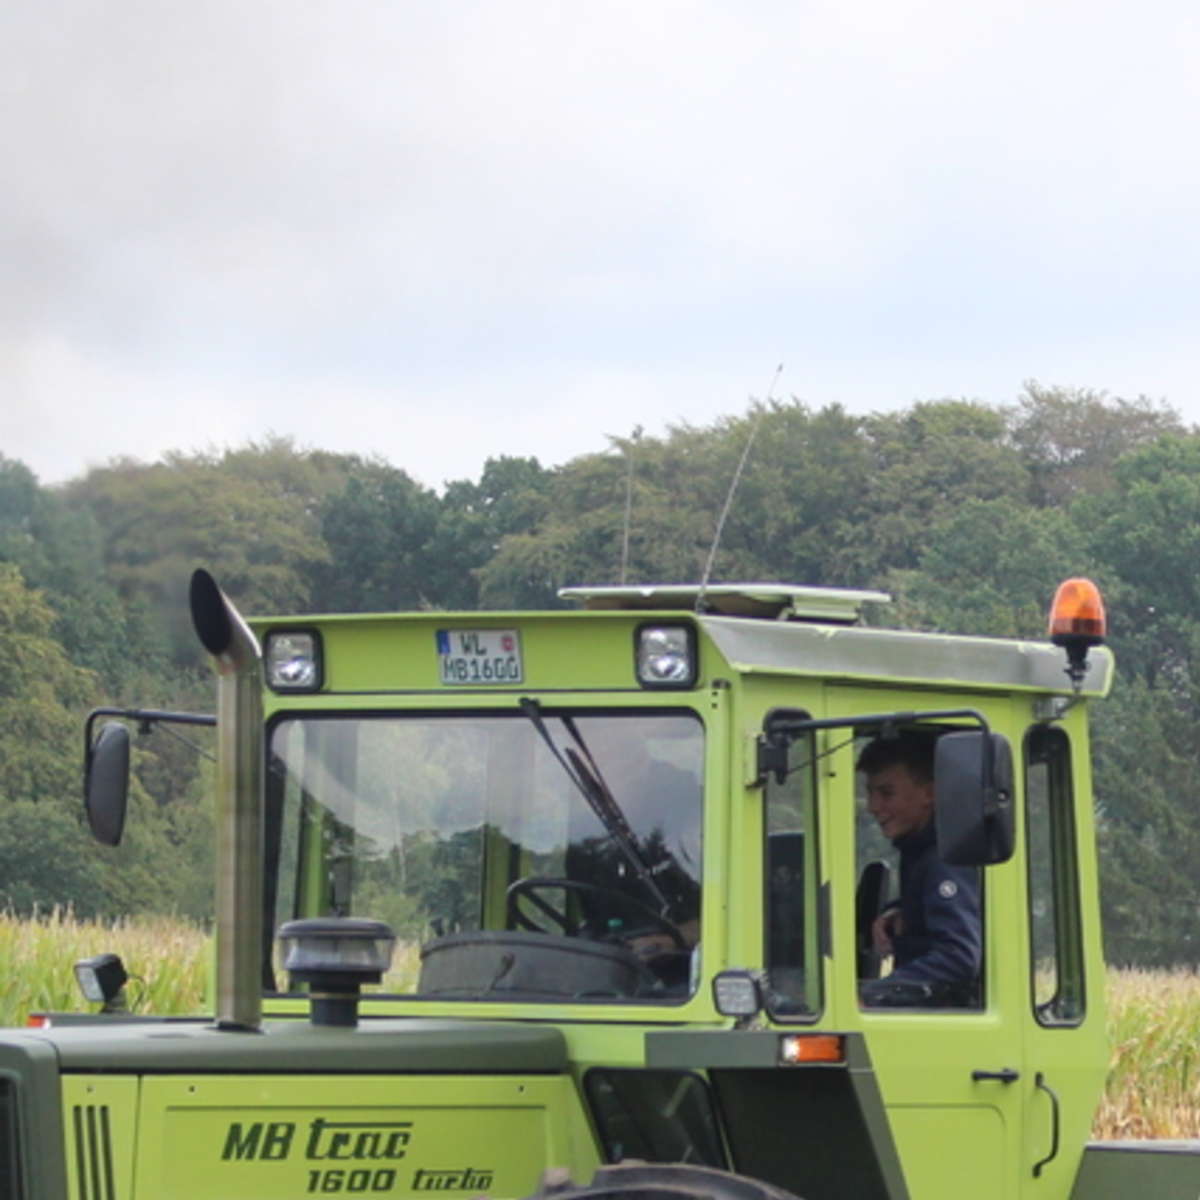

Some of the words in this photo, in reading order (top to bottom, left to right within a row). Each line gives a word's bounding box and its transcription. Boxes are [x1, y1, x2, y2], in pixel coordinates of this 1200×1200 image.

[460, 632, 487, 656] WL
[221, 1122, 296, 1160] MB
[305, 1118, 413, 1160] trac
[307, 1168, 397, 1193] 1600
[411, 1168, 494, 1191] turbo
